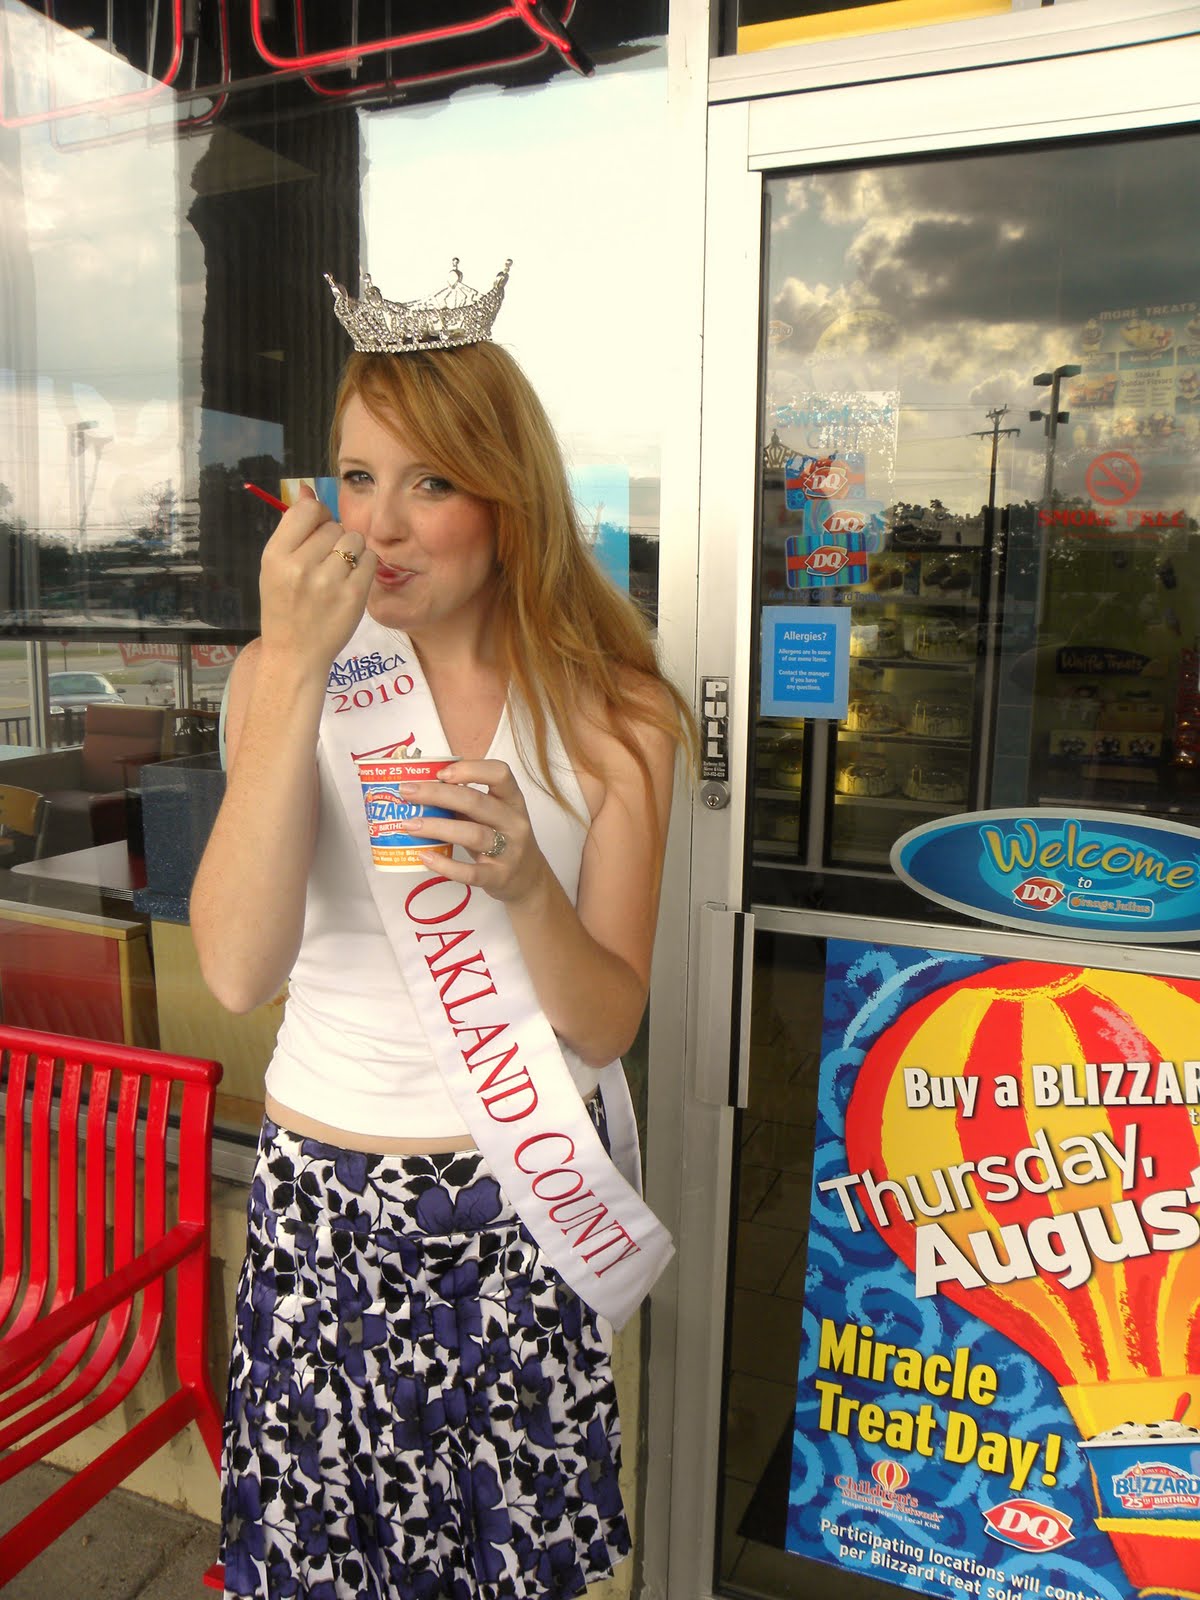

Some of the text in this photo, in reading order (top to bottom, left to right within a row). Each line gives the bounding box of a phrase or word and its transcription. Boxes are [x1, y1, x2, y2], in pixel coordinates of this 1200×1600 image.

[811, 473, 840, 490] DQ
[829, 517, 859, 532] DQ
[1038, 508, 1185, 528] SMOKE FREE
[813, 552, 841, 568] DQ
[783, 631, 827, 643] Allergies?
[332, 674, 414, 713] 2010
[704, 681, 728, 758] PULL
[375, 767, 387, 775] for
[389, 767, 402, 775] 25
[405, 766, 431, 774] Years
[379, 822, 403, 832] BIRTH
[984, 822, 1196, 889] Welcome
[1020, 884, 1057, 905] DQ
[1077, 876, 1093, 889] to
[1071, 895, 1150, 913] Orange Julius
[404, 875, 642, 1278] OAKLAND COUNTY
[904, 1067, 979, 1118] Buy
[994, 1073, 1019, 1107] a
[818, 1123, 1155, 1233] Thursday,
[818, 1318, 998, 1407] Miracle
[815, 1379, 1062, 1492] Treat Day!
[834, 1475, 919, 1508] Children's
[1116, 1476, 1200, 1496] BLIZZARD
[1154, 1495, 1197, 1505] BIRTHDAY
[841, 1488, 942, 1523] Miracle Network
[841, 1499, 940, 1530] Hospitals Helping Local Kids
[997, 1506, 1060, 1546] DQ
[820, 1518, 924, 1562] Participating
[928, 1549, 1005, 1583] locations
[1011, 1574, 1040, 1593] will
[839, 1543, 866, 1561] per
[870, 1550, 936, 1581] Blizzard
[939, 1570, 982, 1595] treat
